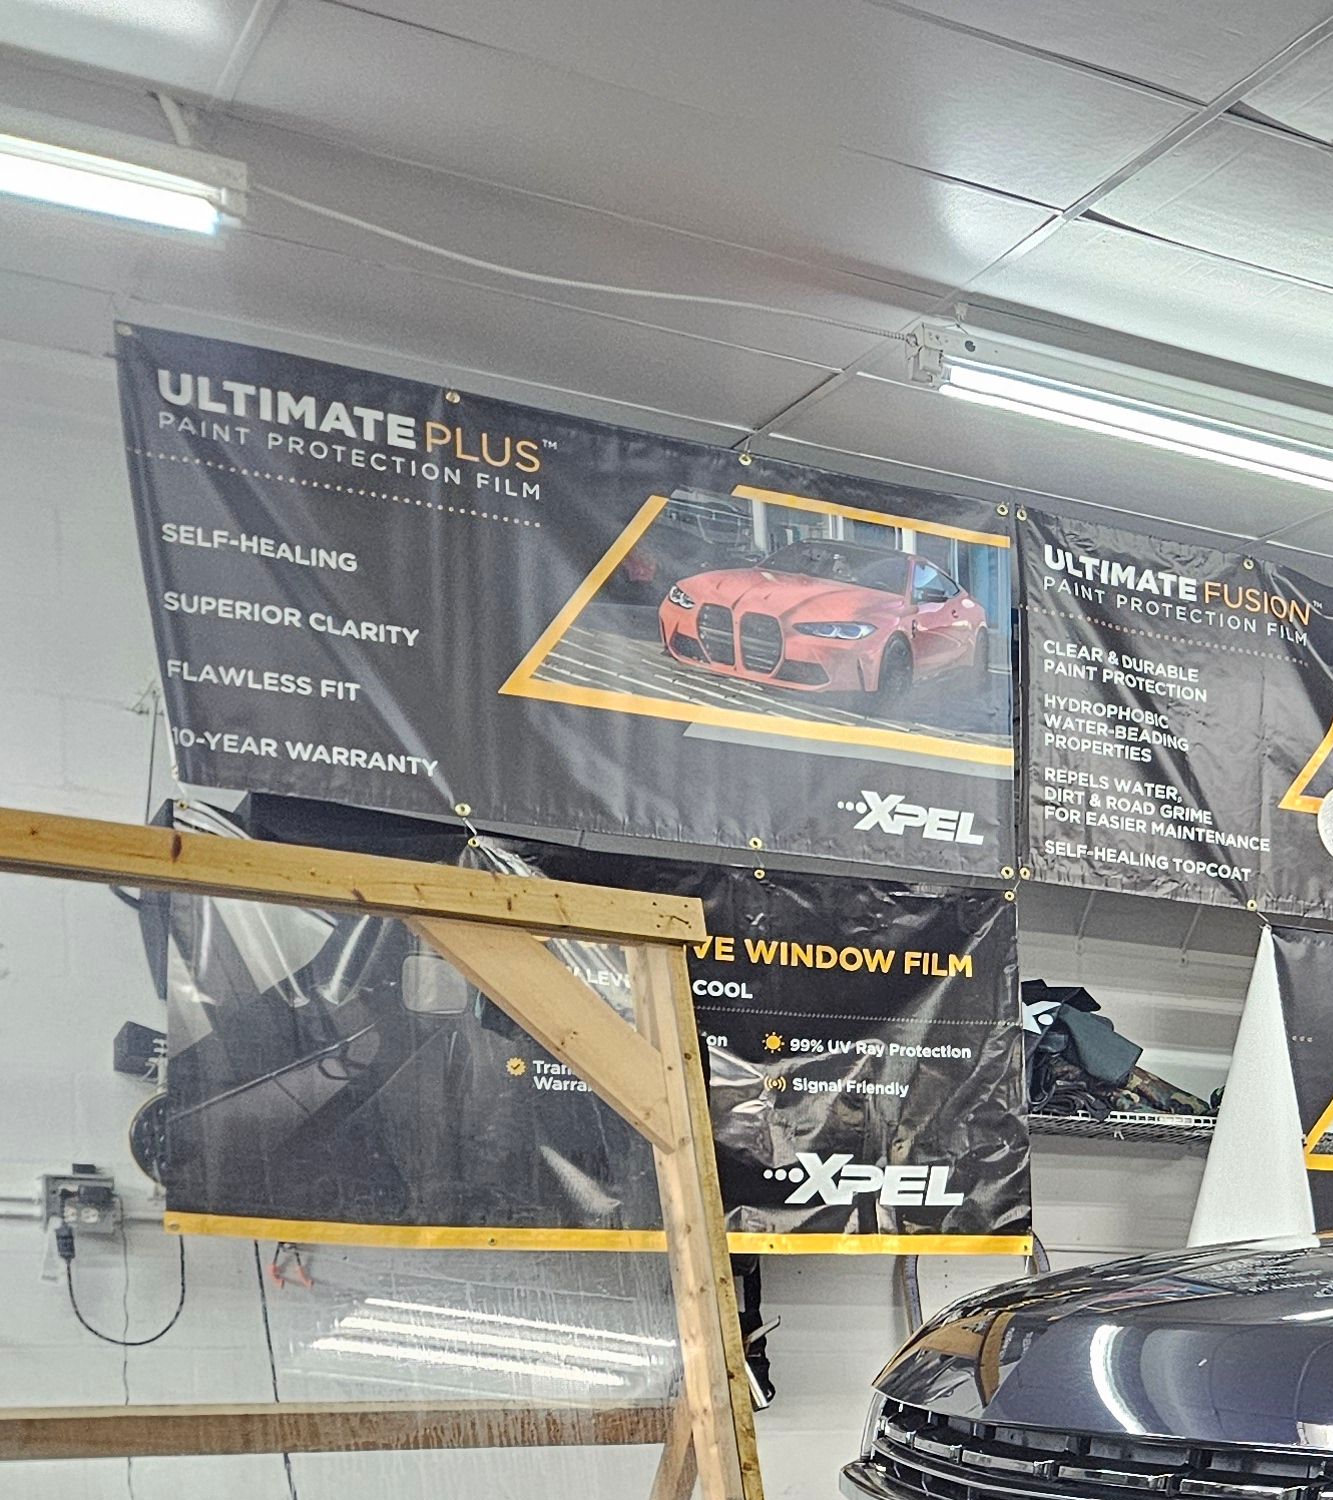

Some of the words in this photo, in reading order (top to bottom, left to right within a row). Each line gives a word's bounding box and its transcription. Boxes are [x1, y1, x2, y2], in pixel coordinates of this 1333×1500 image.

[158, 369, 416, 450] ULTIMATE
[158, 412, 250, 445] PAINT
[268, 432, 461, 485] PROTECTION
[476, 474, 541, 501] FILM
[162, 523, 358, 572] SELF-HEALING
[1044, 545, 1198, 602] ULTIMATE
[162, 592, 302, 627] SUPERIOR
[309, 613, 420, 647] CLARITY
[1043, 577, 1105, 604] PAINT
[1116, 594, 1257, 634] PROTECTION
[1267, 623, 1308, 646] FILM
[166, 660, 312, 695] FLAWLESS
[321, 679, 361, 701] FIT
[1043, 640, 1104, 663] CLEAR
[1108, 650, 1119, 665] &
[1122, 654, 1199, 683] DURABLE
[1044, 660, 1095, 681] PAINT
[1102, 670, 1207, 702] PROTECTION
[1044, 694, 1169, 729] HYDROPHOBIC
[171, 726, 278, 758] 10-YEAR
[285, 741, 438, 777] WARRANTY
[1044, 715, 1189, 752] WATER-BEADING
[1044, 734, 1152, 763] PROPERTIES
[1044, 768, 1109, 791] REPELS
[1114, 778, 1182, 802] WATER,
[854, 790, 984, 845] XPEL
[1044, 787, 1085, 805] DIRT
[1089, 792, 1100, 808] &
[1106, 795, 1156, 816] ROAD
[1159, 804, 1213, 826] GRIME
[1044, 806, 1081, 825] FOR
[1086, 812, 1146, 833] EASIER
[1151, 822, 1270, 852] MAINTENANCE
[1044, 840, 1169, 870] SELF-HEALING
[1173, 858, 1251, 882] TOPCOAT
[744, 938, 895, 974] WINDOW
[905, 951, 973, 978] FILM
[693, 980, 753, 1000] COOL
[790, 1038, 824, 1053] 99%
[827, 1040, 851, 1055] UV
[856, 1042, 886, 1059] Ray
[890, 1043, 972, 1059] Protection
[533, 1077, 593, 1092] Warra
[793, 1078, 844, 1095] Signal
[846, 1080, 909, 1098] Friendly
[785, 1152, 964, 1206] XPEL
